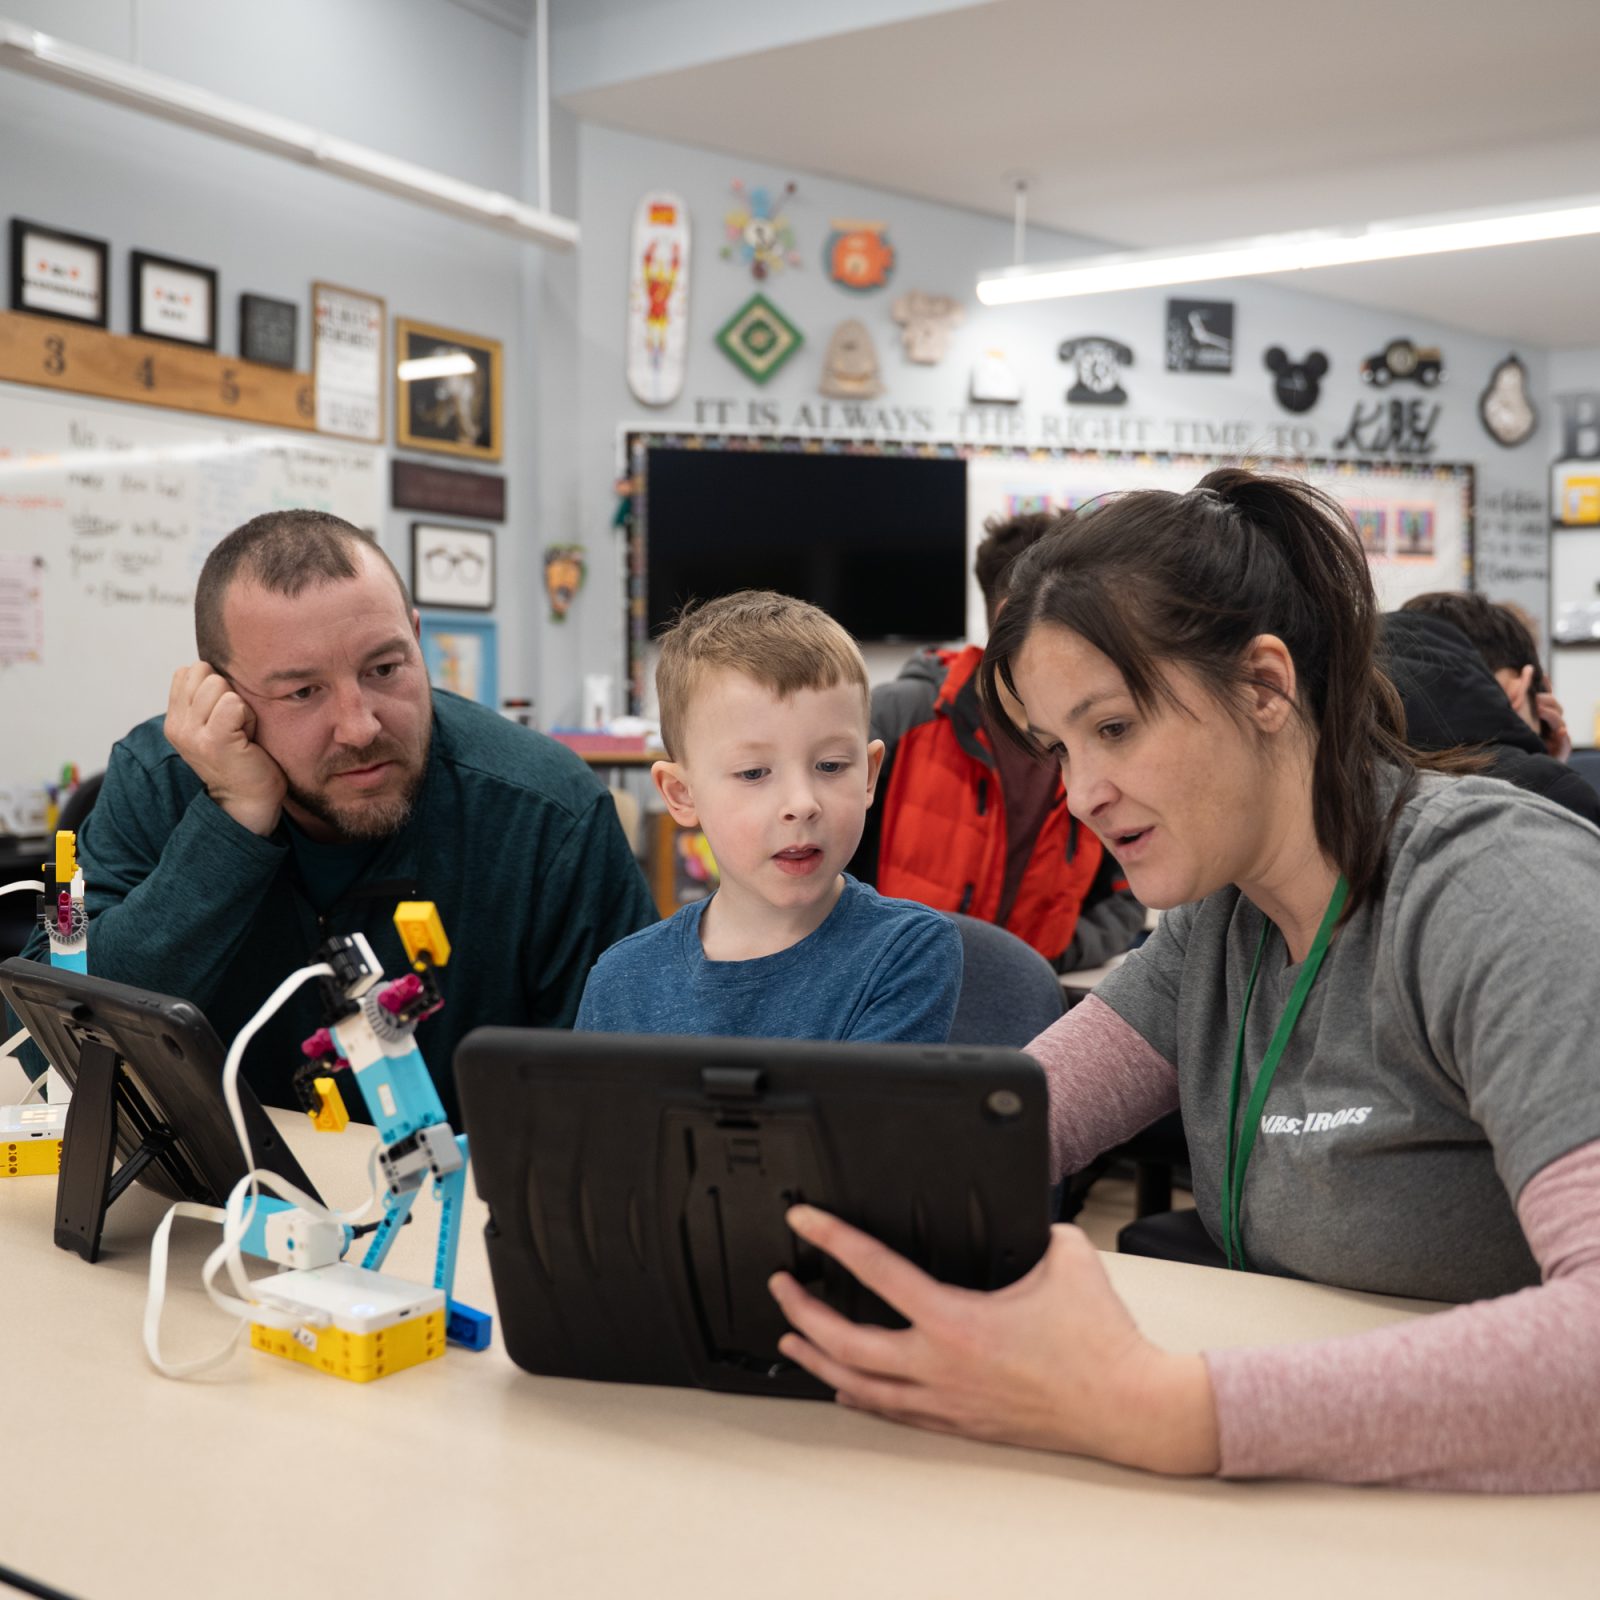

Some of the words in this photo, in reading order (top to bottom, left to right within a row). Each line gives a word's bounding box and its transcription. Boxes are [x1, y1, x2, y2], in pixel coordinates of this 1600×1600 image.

[44, 334, 66, 376] 3
[136, 357, 156, 391] 4
[221, 368, 240, 405] 5
[694, 398, 734, 425] IT
[746, 401, 780, 430] IS
[792, 403, 936, 433] ALWAYS
[954, 408, 1024, 438] THE
[1040, 413, 1154, 444] RIGHT
[1166, 417, 1250, 446] TIME
[1268, 422, 1318, 451] TO
[1260, 1114, 1304, 1135] MRS.
[1302, 1106, 1373, 1133] IROIS
